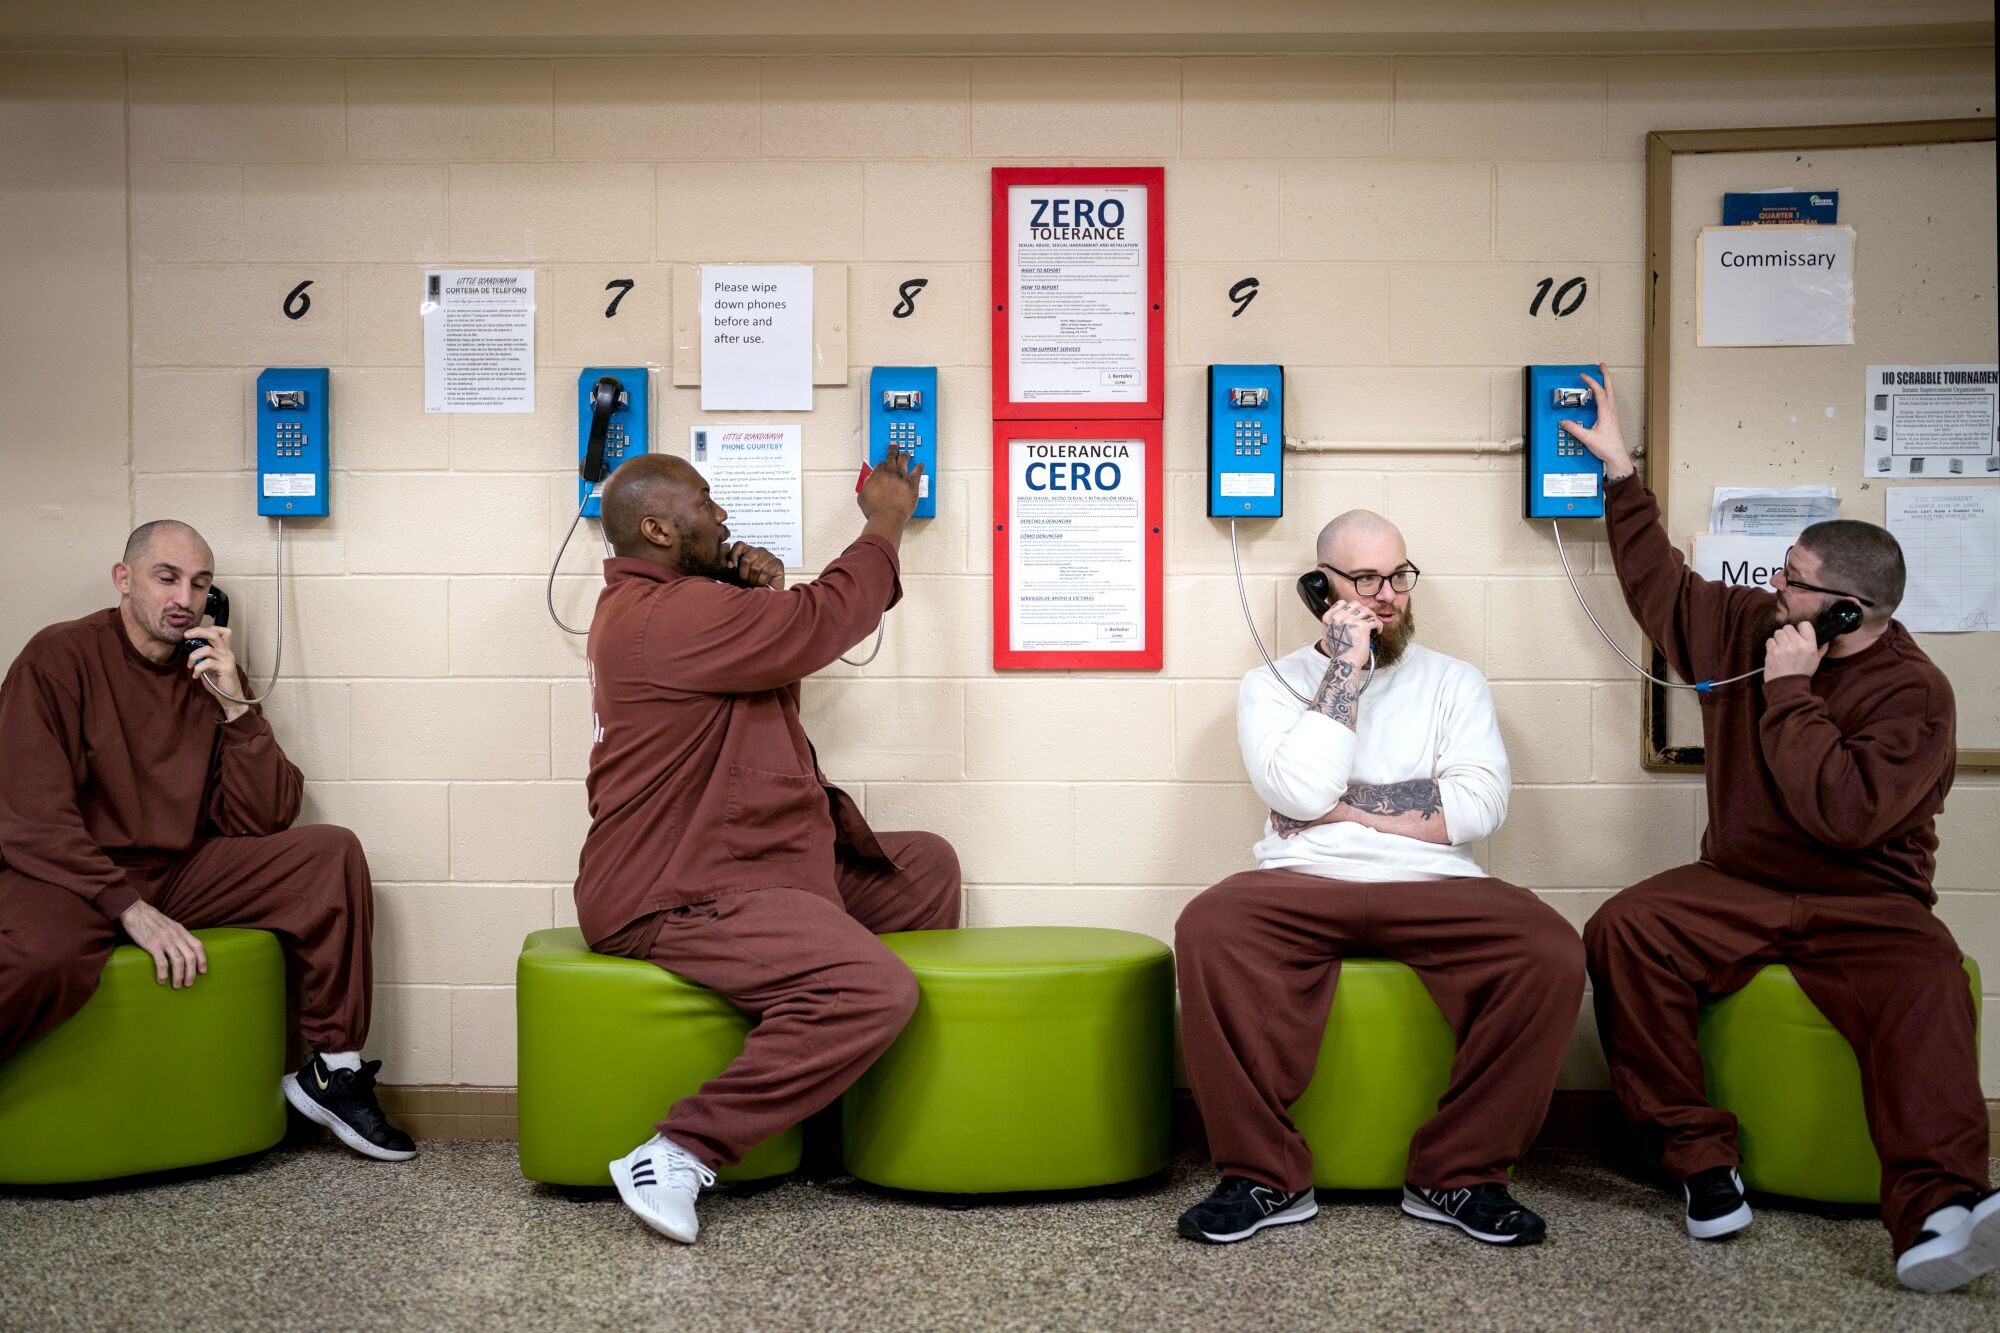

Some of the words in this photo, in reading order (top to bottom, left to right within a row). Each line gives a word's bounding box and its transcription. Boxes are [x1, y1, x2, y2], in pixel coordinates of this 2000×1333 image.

[1030, 199, 1125, 228] ZERO
[1030, 228, 1125, 240] TOLERANCE
[1720, 250, 1836, 270] Commissary
[714, 282, 748, 292] Please
[752, 282, 777, 294] wipe
[1229, 277, 1259, 317] 9
[1529, 277, 1587, 317] 10
[283, 280, 315, 320] 6
[605, 279, 634, 318] 7
[714, 300, 744, 310] down
[748, 300, 787, 311] phones
[893, 279, 928, 318] 8
[714, 316, 749, 326] before
[752, 316, 772, 326] and
[714, 333, 740, 344] after
[743, 336, 764, 344] use.
[1897, 371, 1942, 385] SCRABBLE
[1943, 371, 1999, 385] TOURNAMEN
[1026, 445, 1130, 458] TOLERANCIA
[1025, 462, 1121, 491] CERO
